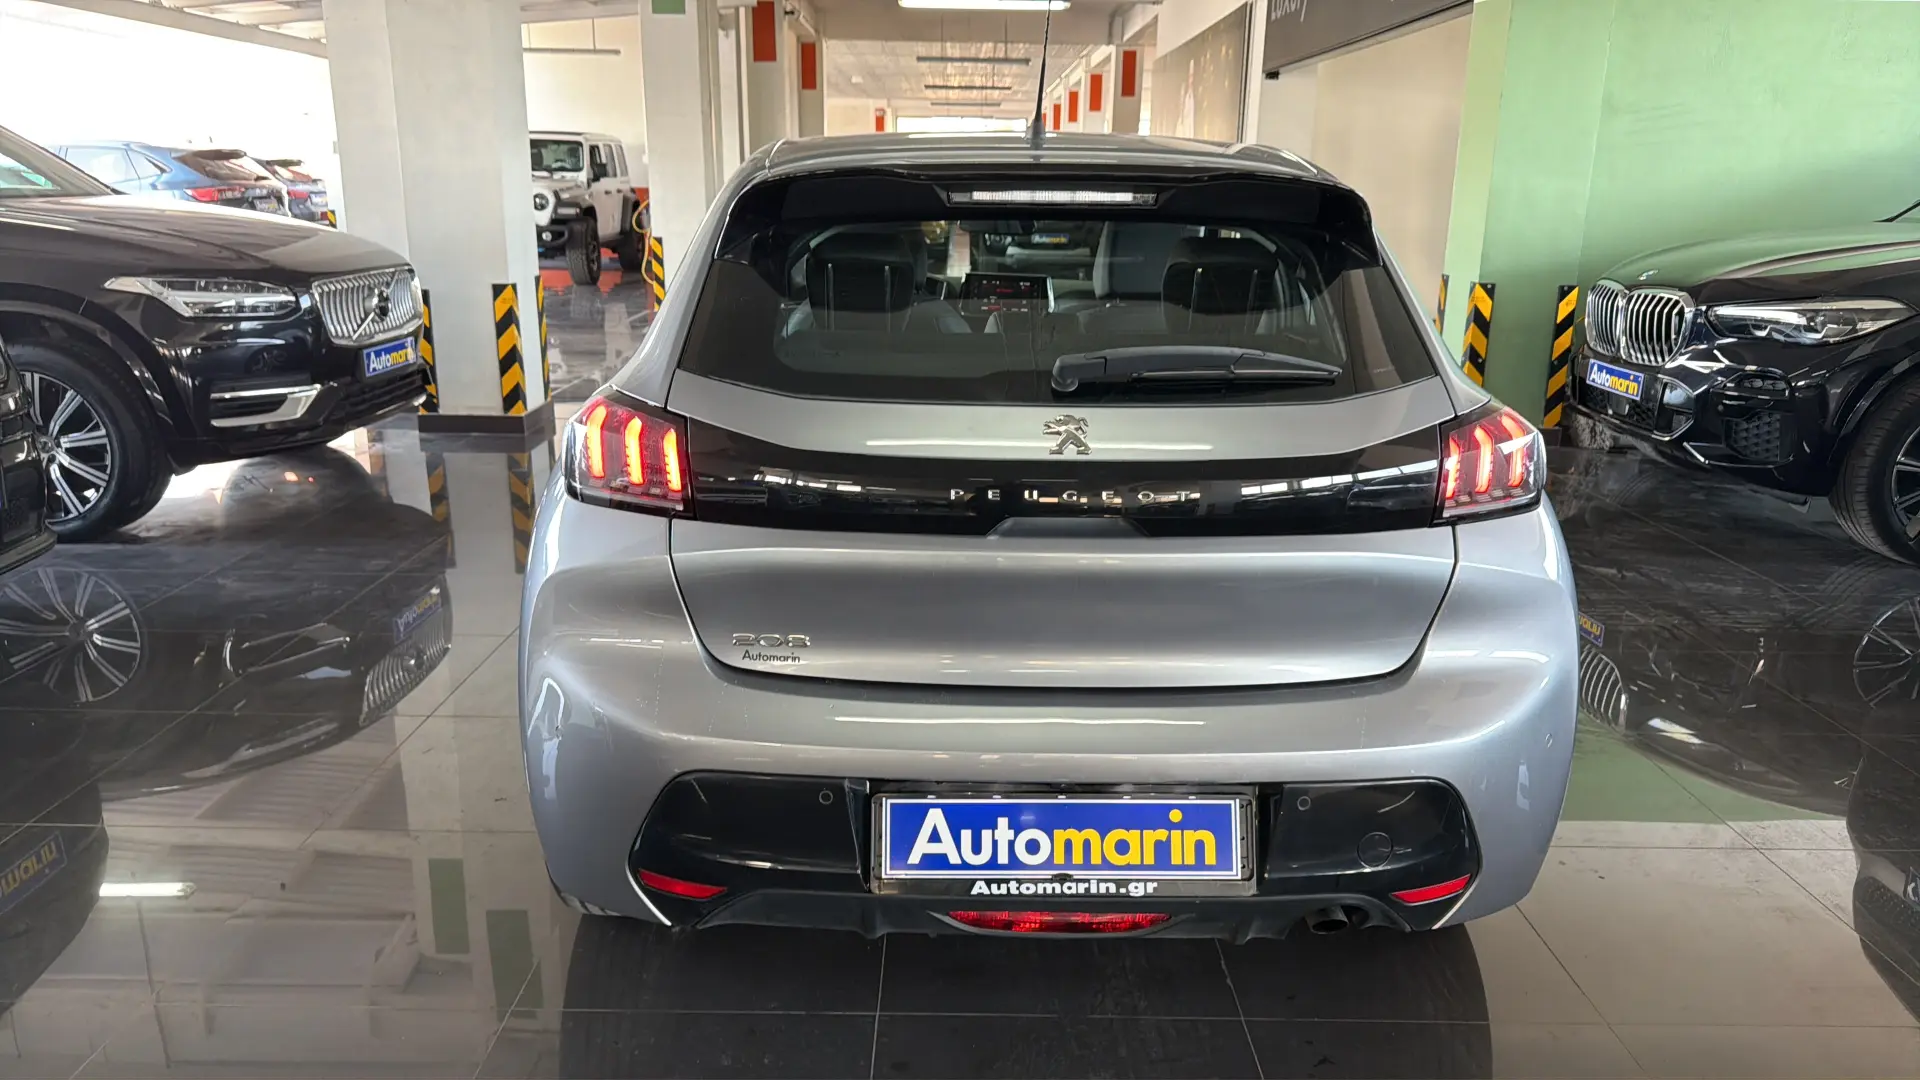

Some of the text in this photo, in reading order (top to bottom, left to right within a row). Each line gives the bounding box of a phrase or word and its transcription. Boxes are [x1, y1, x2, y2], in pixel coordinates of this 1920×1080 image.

[1589, 363, 1639, 396] Automarin
[950, 489, 1190, 502] PEUGEOT
[732, 632, 811, 648] 208
[741, 648, 801, 663] Automarin
[906, 807, 1217, 867] Automarin
[970, 879, 1159, 897] Automarin.gr
